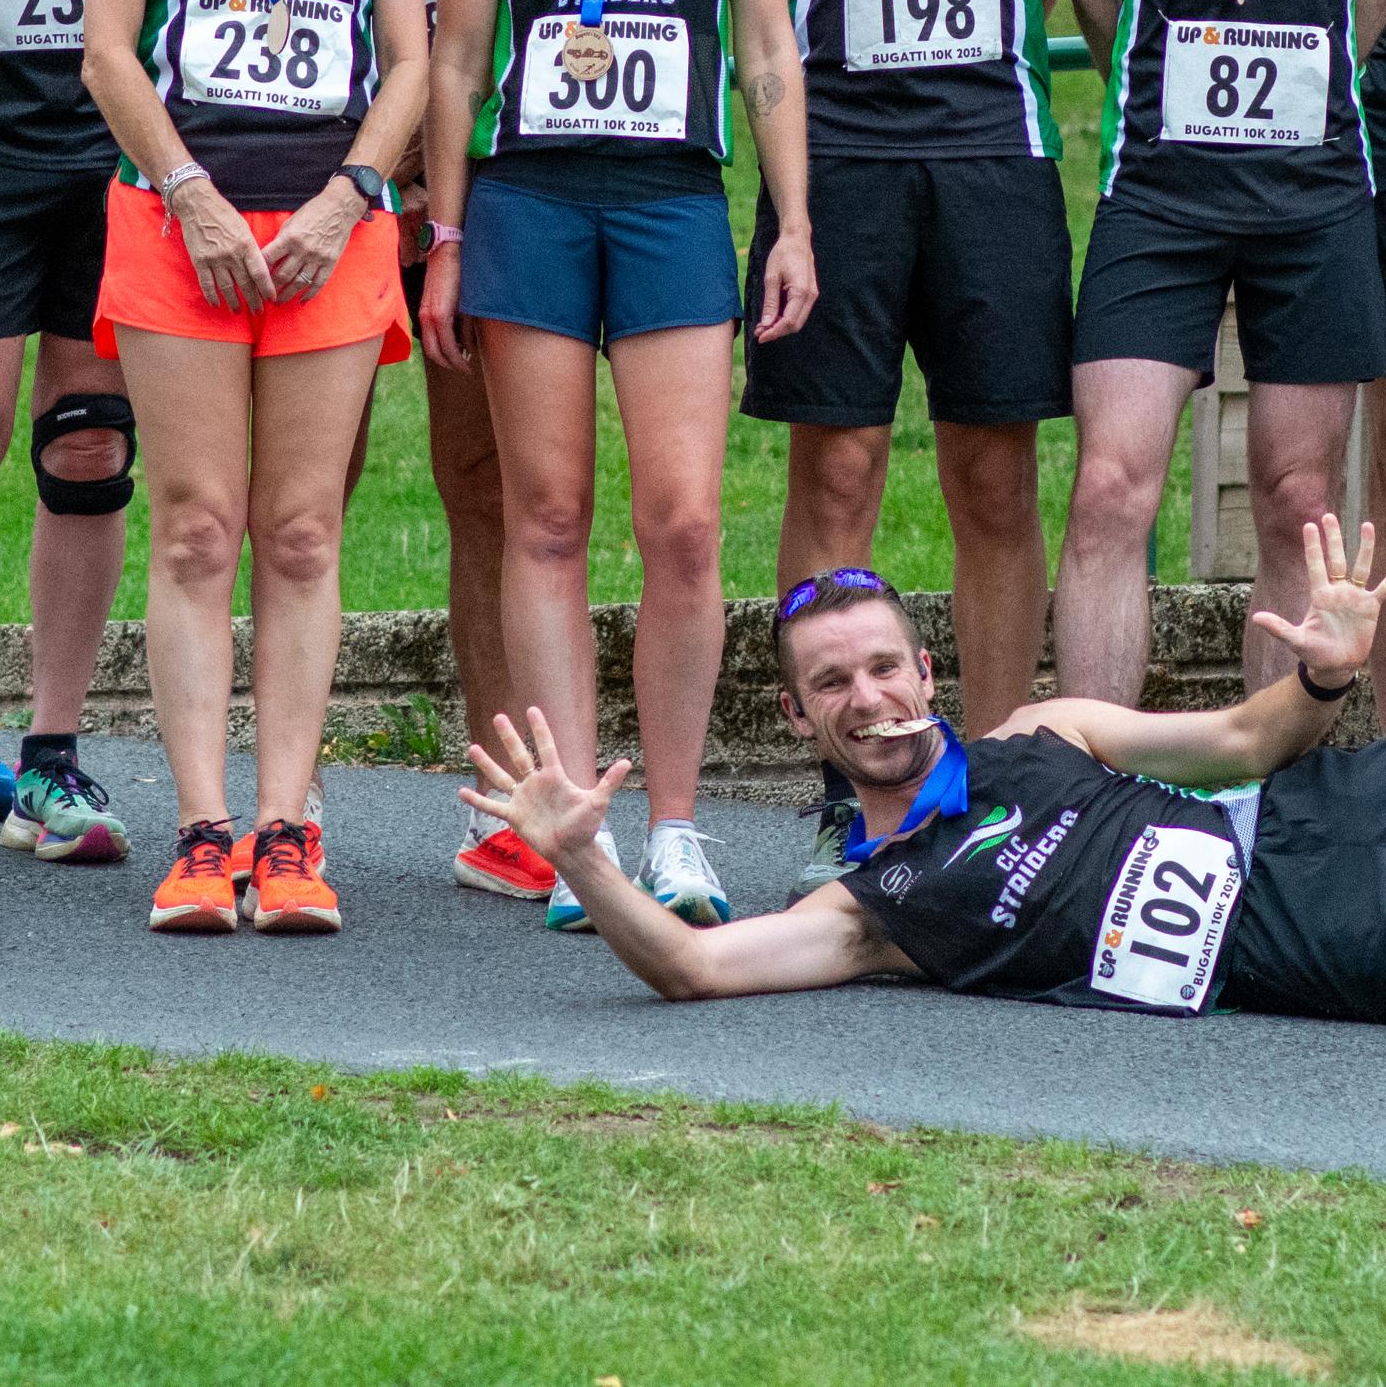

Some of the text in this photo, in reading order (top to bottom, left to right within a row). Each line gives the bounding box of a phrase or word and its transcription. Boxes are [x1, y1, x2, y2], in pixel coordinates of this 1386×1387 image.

[16, 34, 69, 45] BUGATTI
[538, 22, 563, 39] UP
[604, 21, 678, 42] NNING
[1177, 26, 1319, 50] UP & RUNNING
[209, 20, 320, 89] 238
[872, 47, 982, 64] BUGATTI 10K 2025
[549, 49, 656, 112] 300
[1206, 55, 1278, 120] 82
[207, 88, 322, 110] BUGATTI 10K 2025
[546, 118, 660, 133] BUGATTI 10K 2025
[1185, 125, 1300, 140] BUGATTI 10K 2025
[996, 835, 1028, 871] CLC
[1110, 837, 1160, 927] RUNNING
[1129, 860, 1217, 968] 102
[1104, 929, 1124, 948] &
[1193, 871, 1239, 987] BUGATTI 10K 2025
